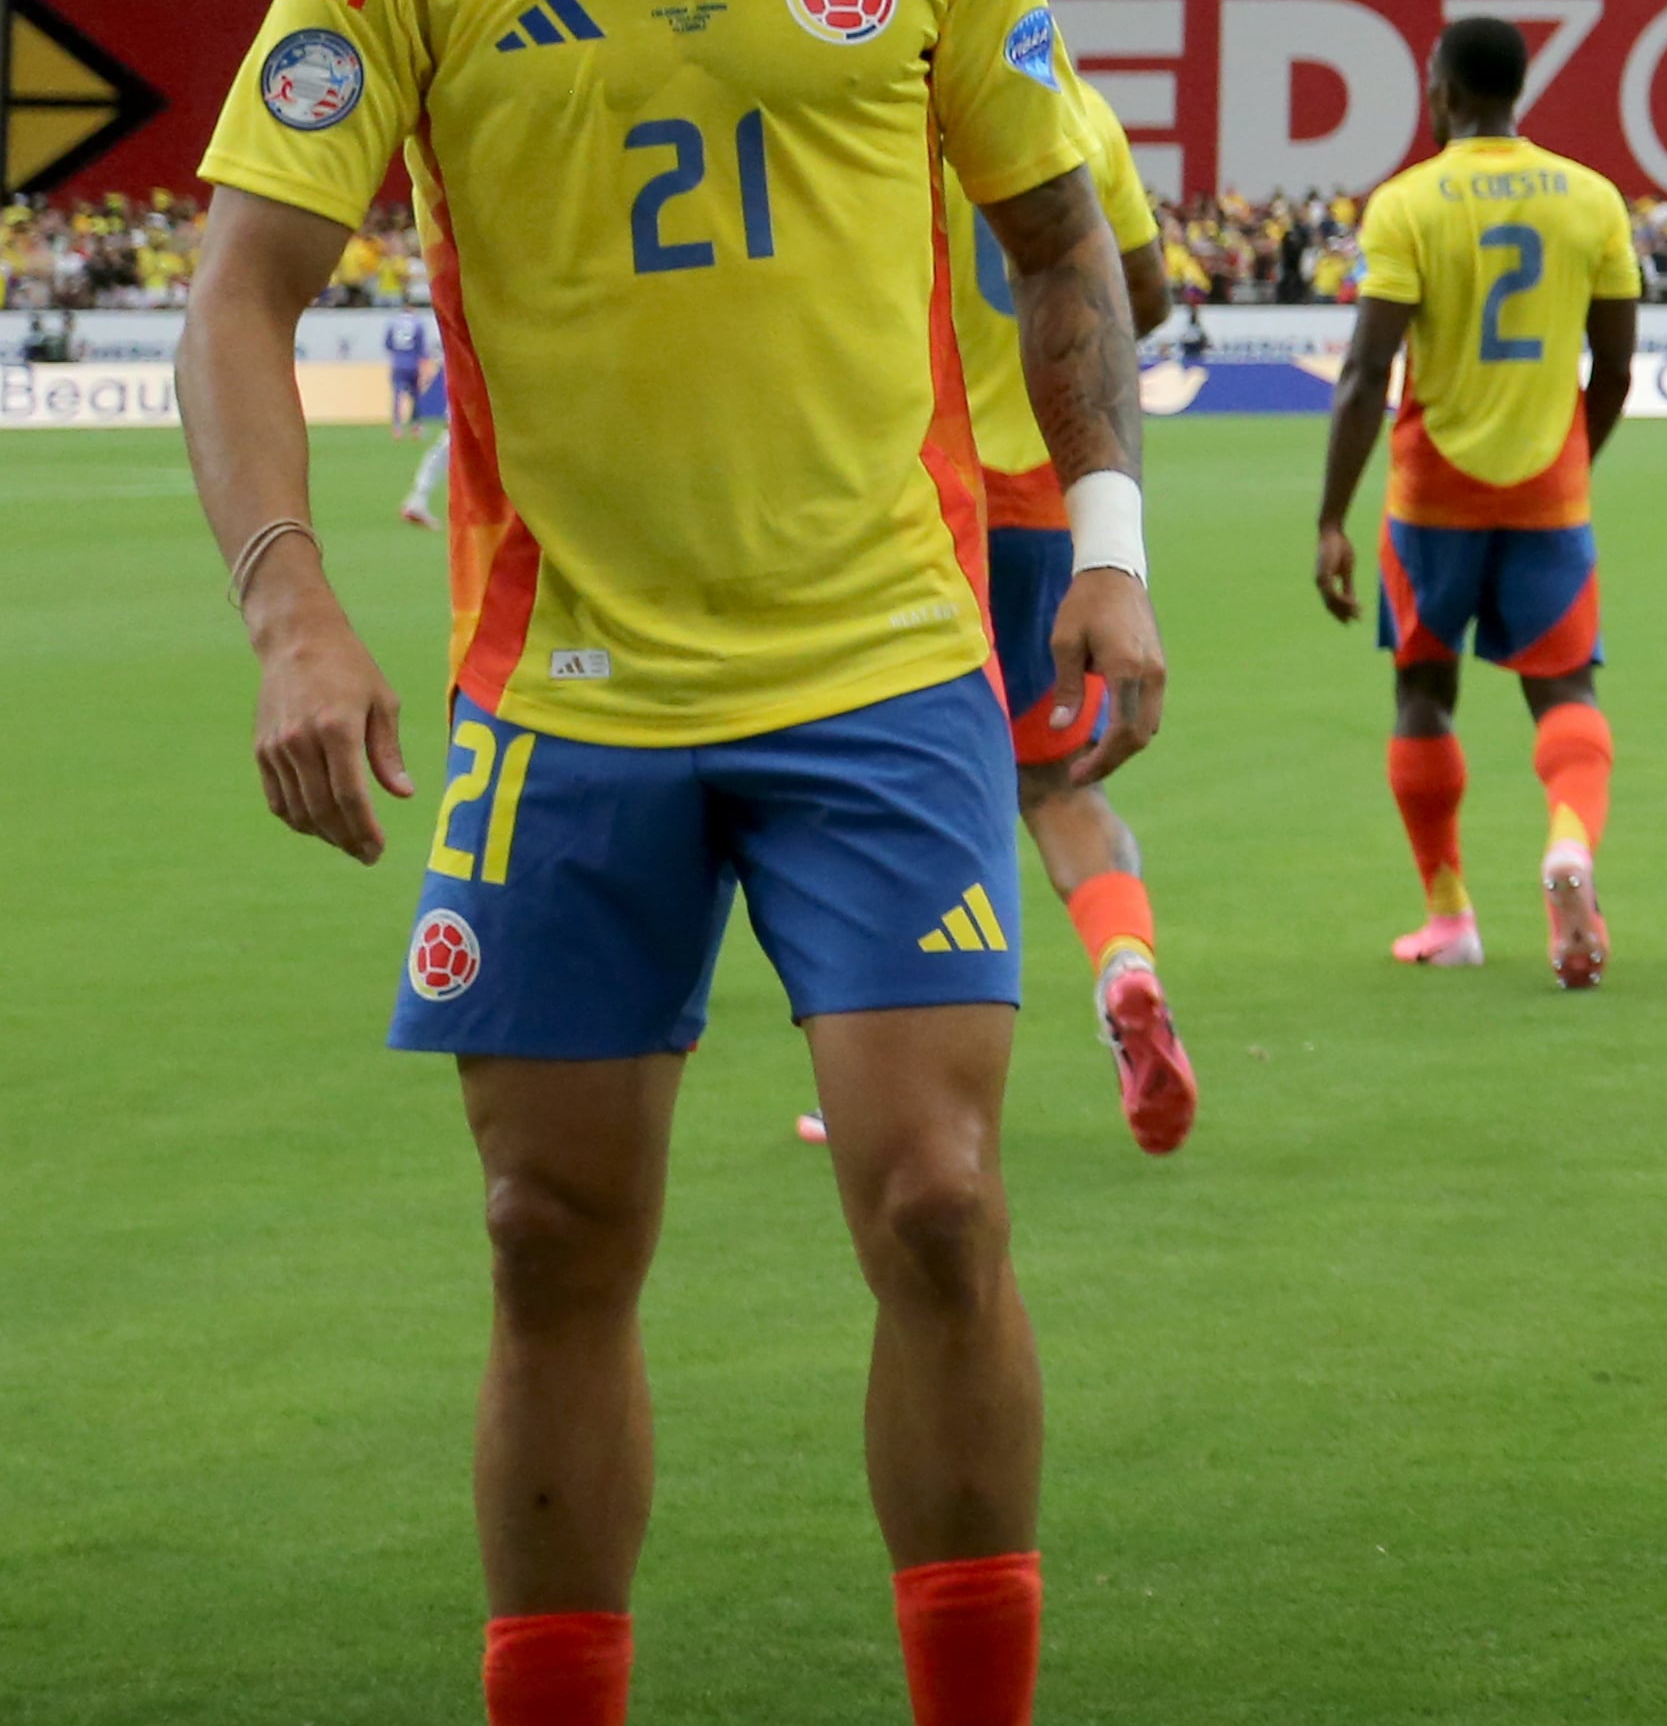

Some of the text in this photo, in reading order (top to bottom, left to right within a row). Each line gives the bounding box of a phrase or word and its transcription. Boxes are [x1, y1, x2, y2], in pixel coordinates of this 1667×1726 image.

[623, 109, 775, 274] 21
[1471, 169, 1568, 200] CUESTA
[1479, 220, 1544, 363] 2
[425, 718, 537, 886] 21
